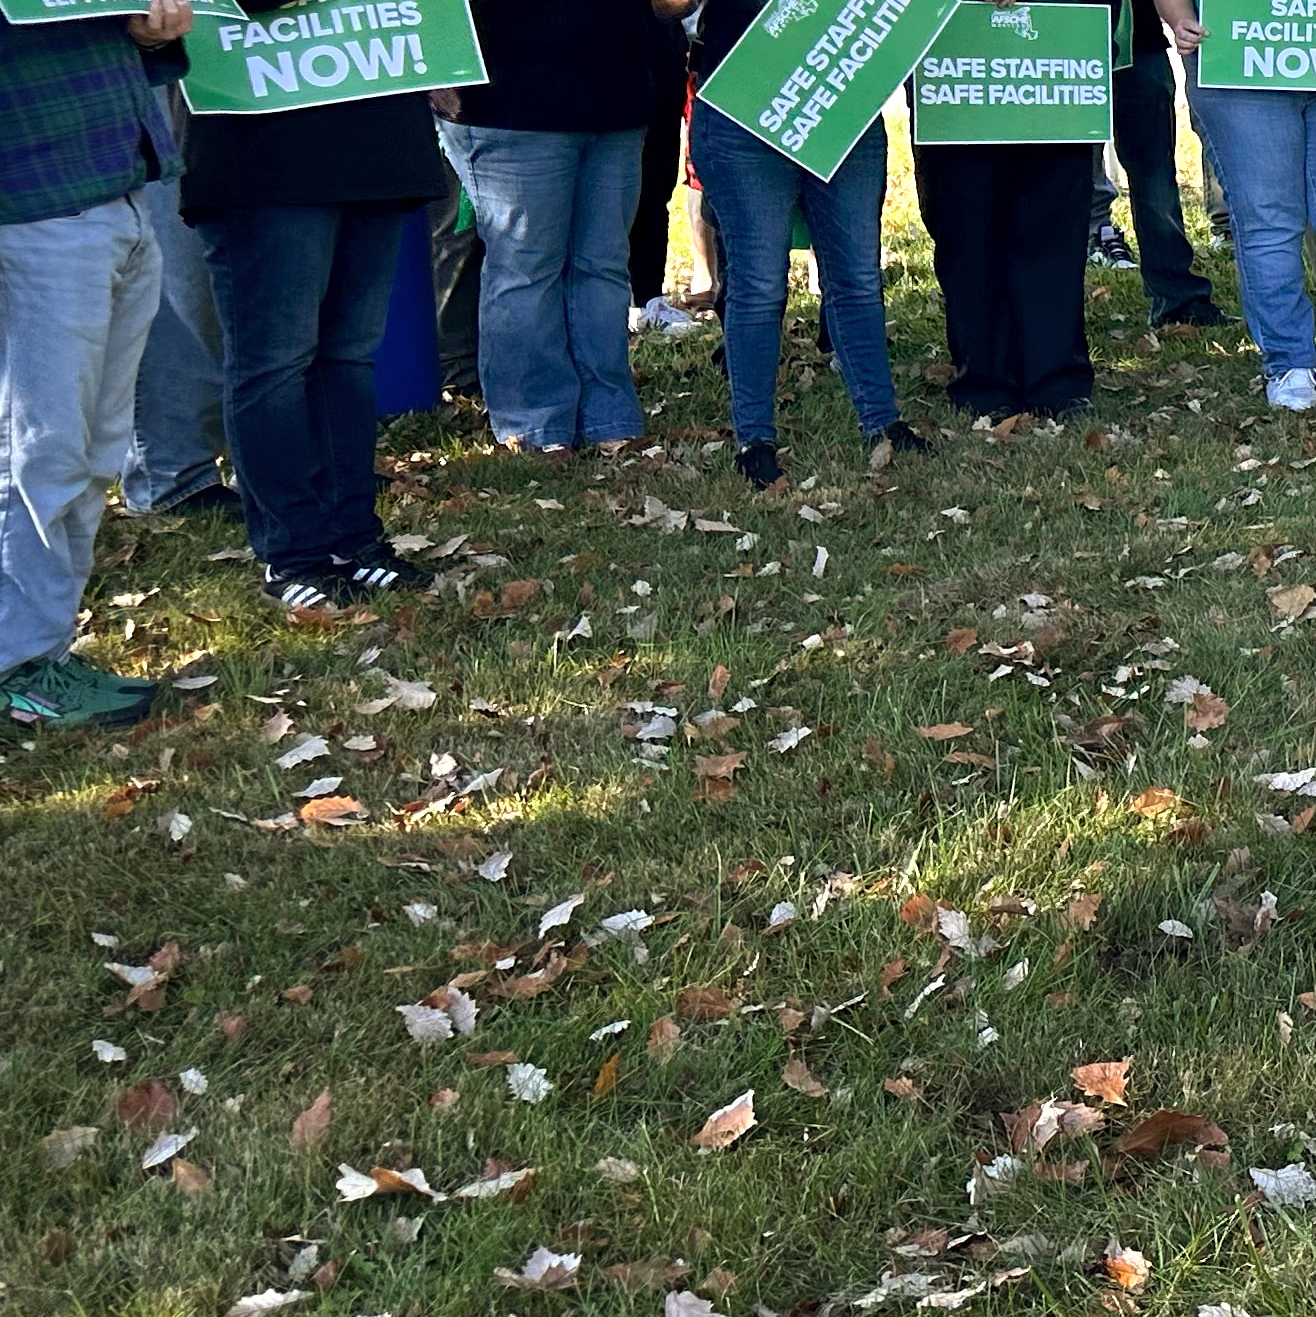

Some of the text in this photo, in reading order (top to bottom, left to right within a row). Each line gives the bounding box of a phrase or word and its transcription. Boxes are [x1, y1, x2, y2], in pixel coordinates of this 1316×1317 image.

[219, 0, 422, 51] FACILITIES
[246, 34, 427, 97] NOW!
[923, 57, 1104, 79] SAFE STAFFING
[759, 66, 816, 132] SAFE
[781, 86, 838, 152] SAFE
[920, 84, 1107, 105] SAFE FACILITIES
